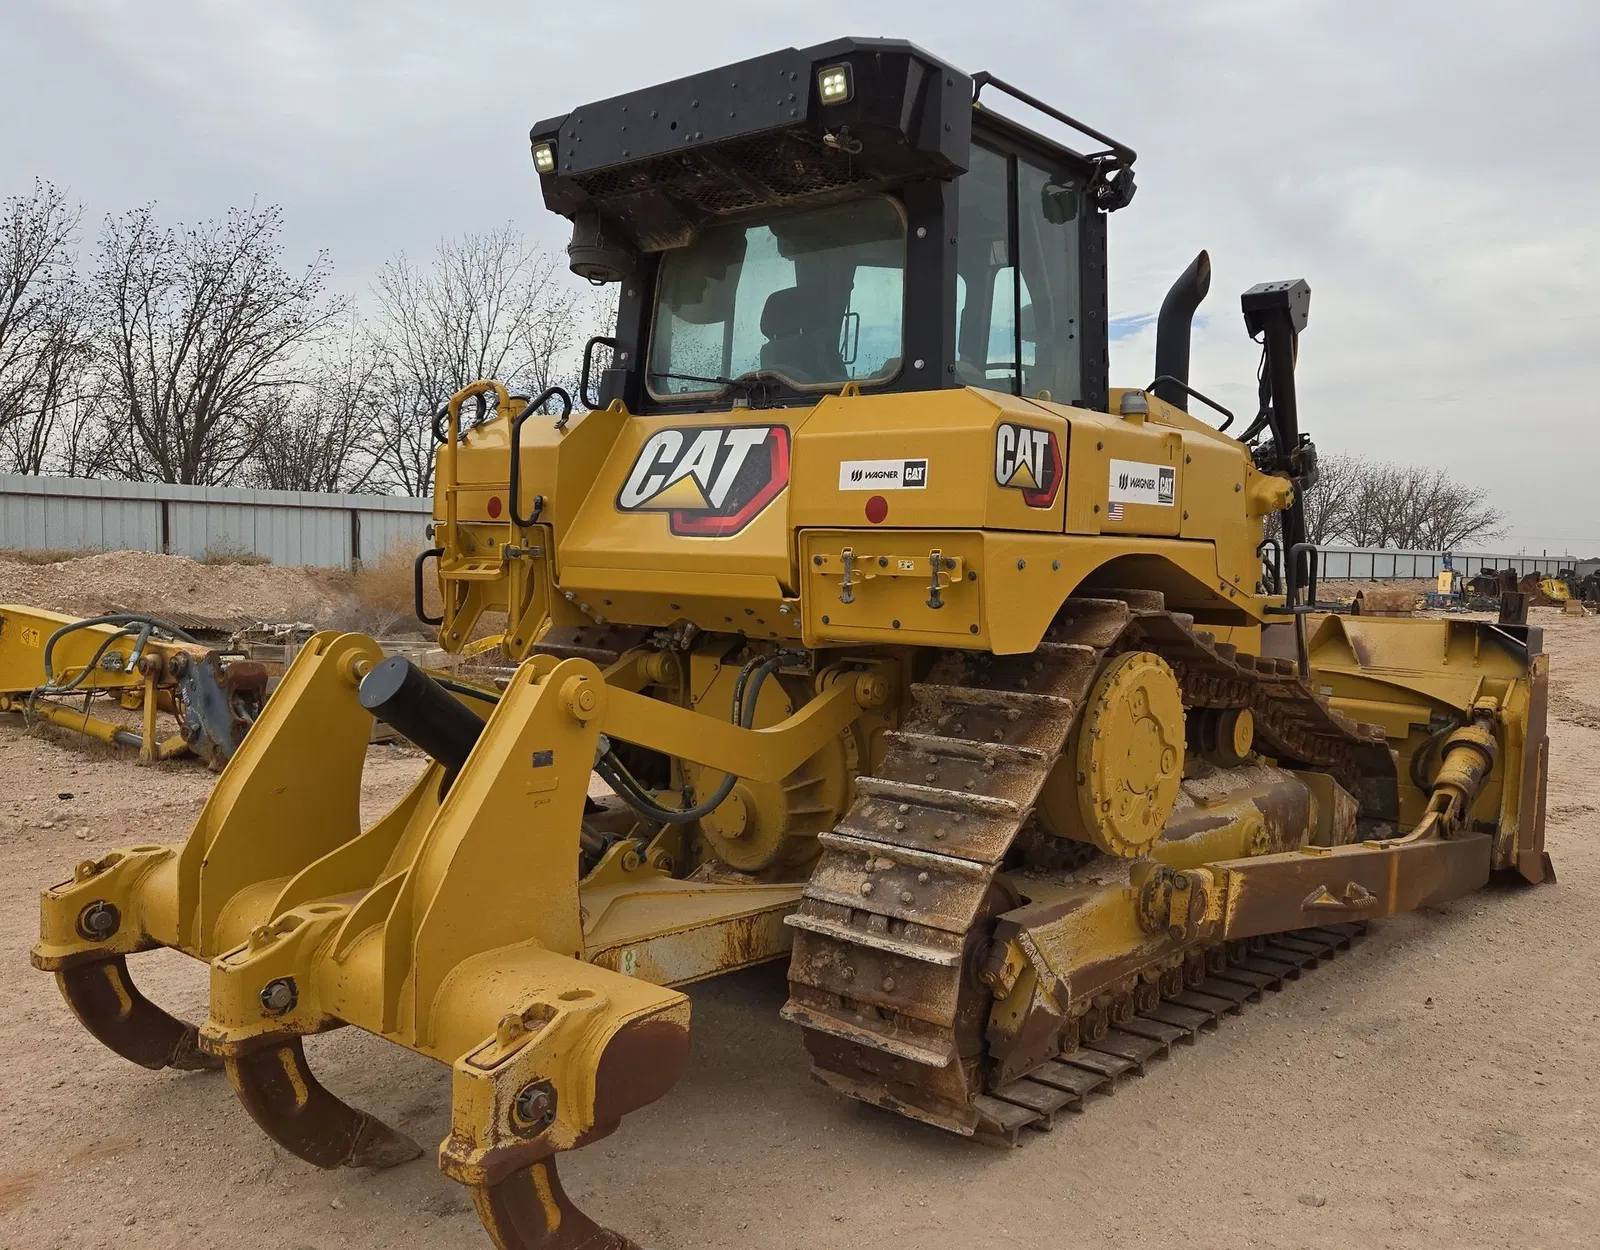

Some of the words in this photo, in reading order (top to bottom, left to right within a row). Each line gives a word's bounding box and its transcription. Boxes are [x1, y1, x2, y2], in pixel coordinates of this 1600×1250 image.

[620, 428, 770, 508] CAT
[865, 471, 898, 479] WAGNER
[905, 467, 925, 480] CAT
[996, 424, 1049, 489] CAT
[1130, 477, 1155, 489] WAGNER
[1160, 477, 1173, 495] CAT
